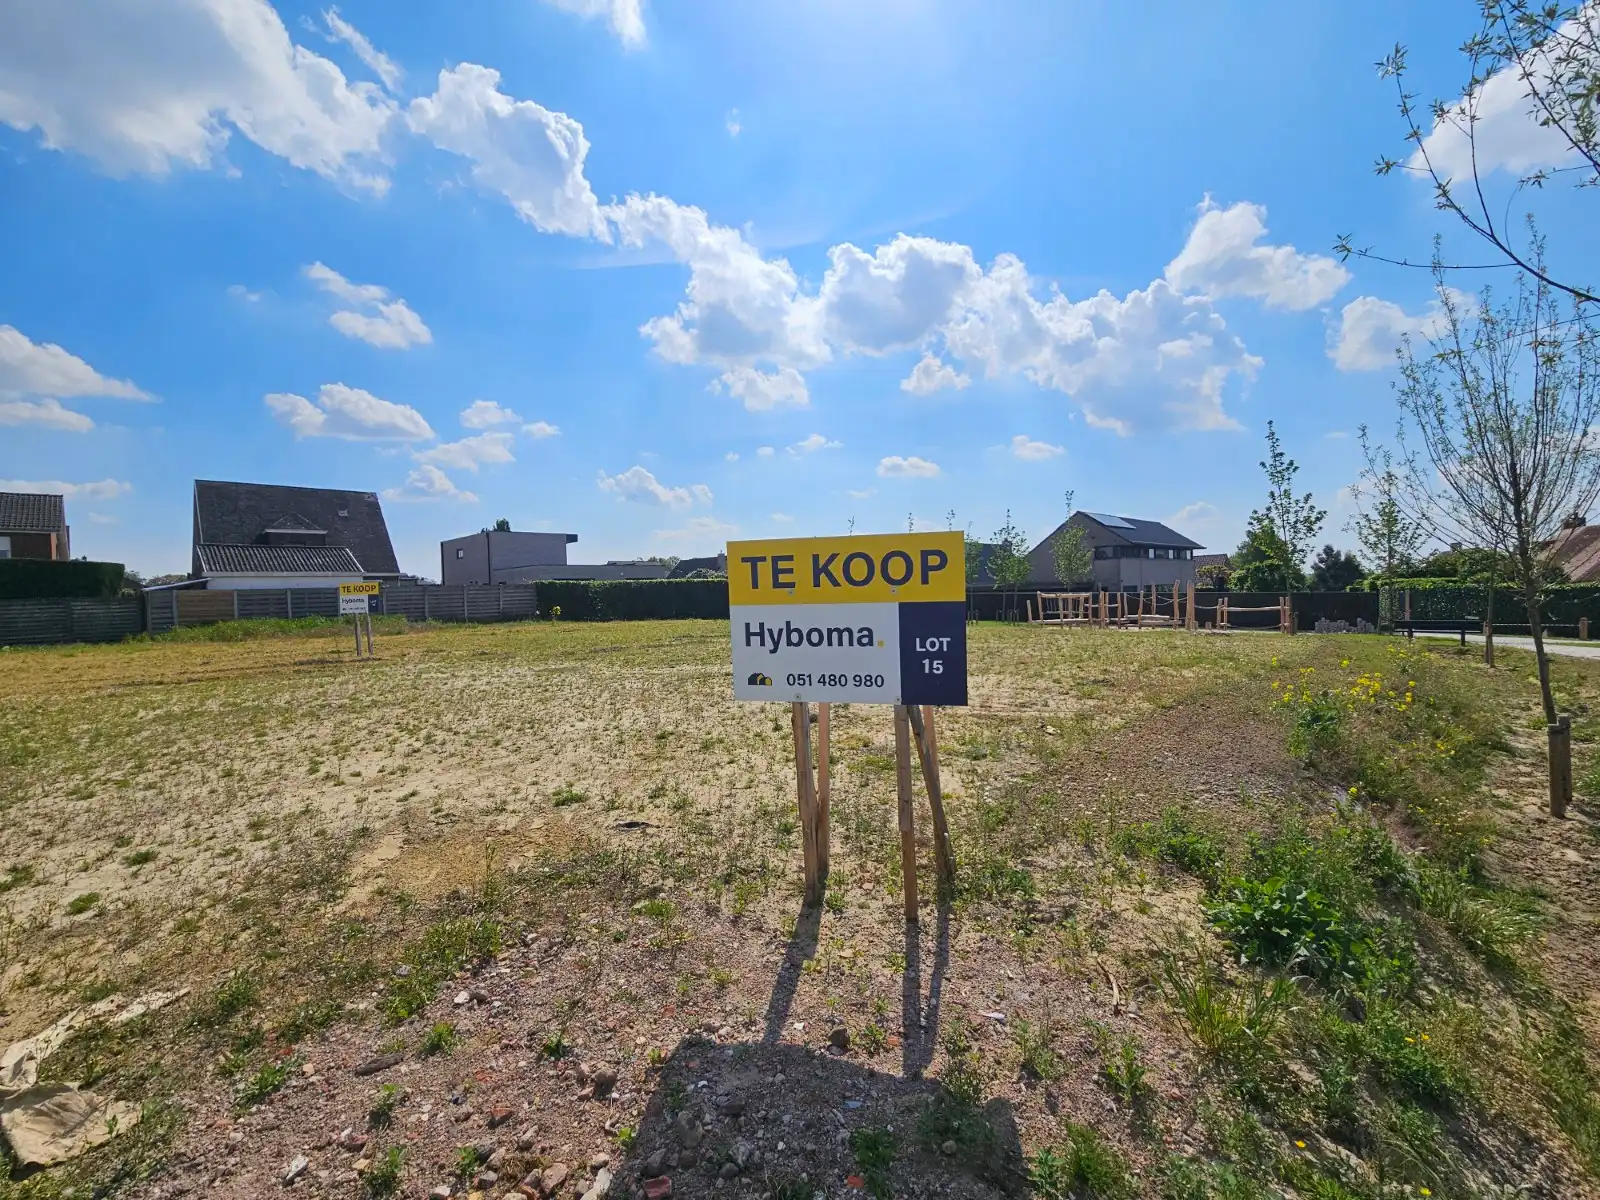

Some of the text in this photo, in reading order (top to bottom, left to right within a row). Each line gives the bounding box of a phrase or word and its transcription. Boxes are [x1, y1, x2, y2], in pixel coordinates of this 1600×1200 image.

[741, 549, 948, 589] TE KOOP
[341, 585, 351, 593] TE
[745, 620, 885, 653] Hyboma.
[915, 637, 951, 652] LOT
[922, 659, 944, 674] 15
[786, 673, 885, 688] 051 480 980
